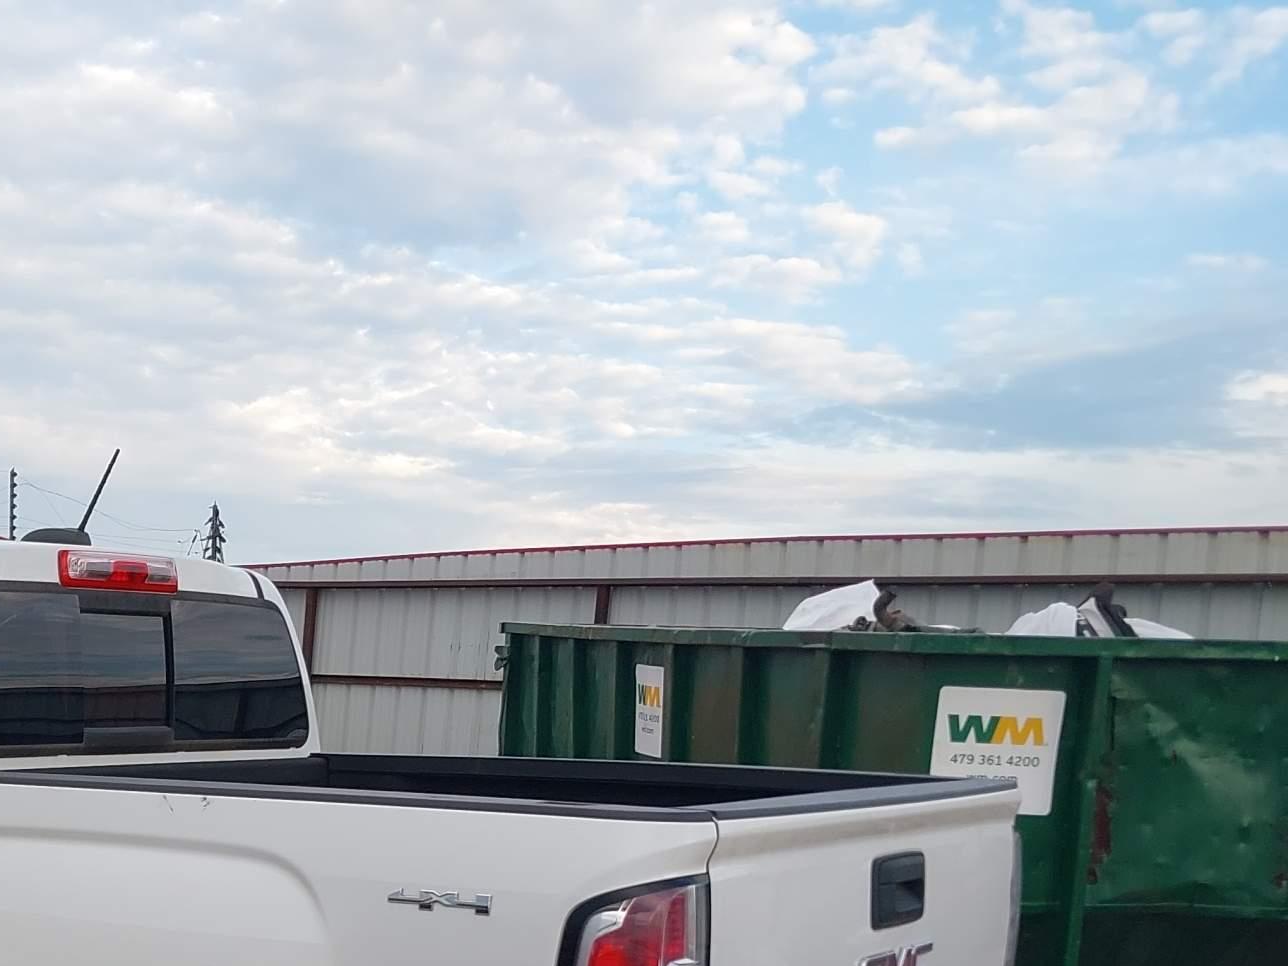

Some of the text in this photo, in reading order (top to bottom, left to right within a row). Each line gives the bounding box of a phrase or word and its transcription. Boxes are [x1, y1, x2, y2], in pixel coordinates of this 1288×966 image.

[638, 684, 661, 708] WM
[948, 713, 1044, 746] WM
[950, 754, 1040, 767] 479 361 4200
